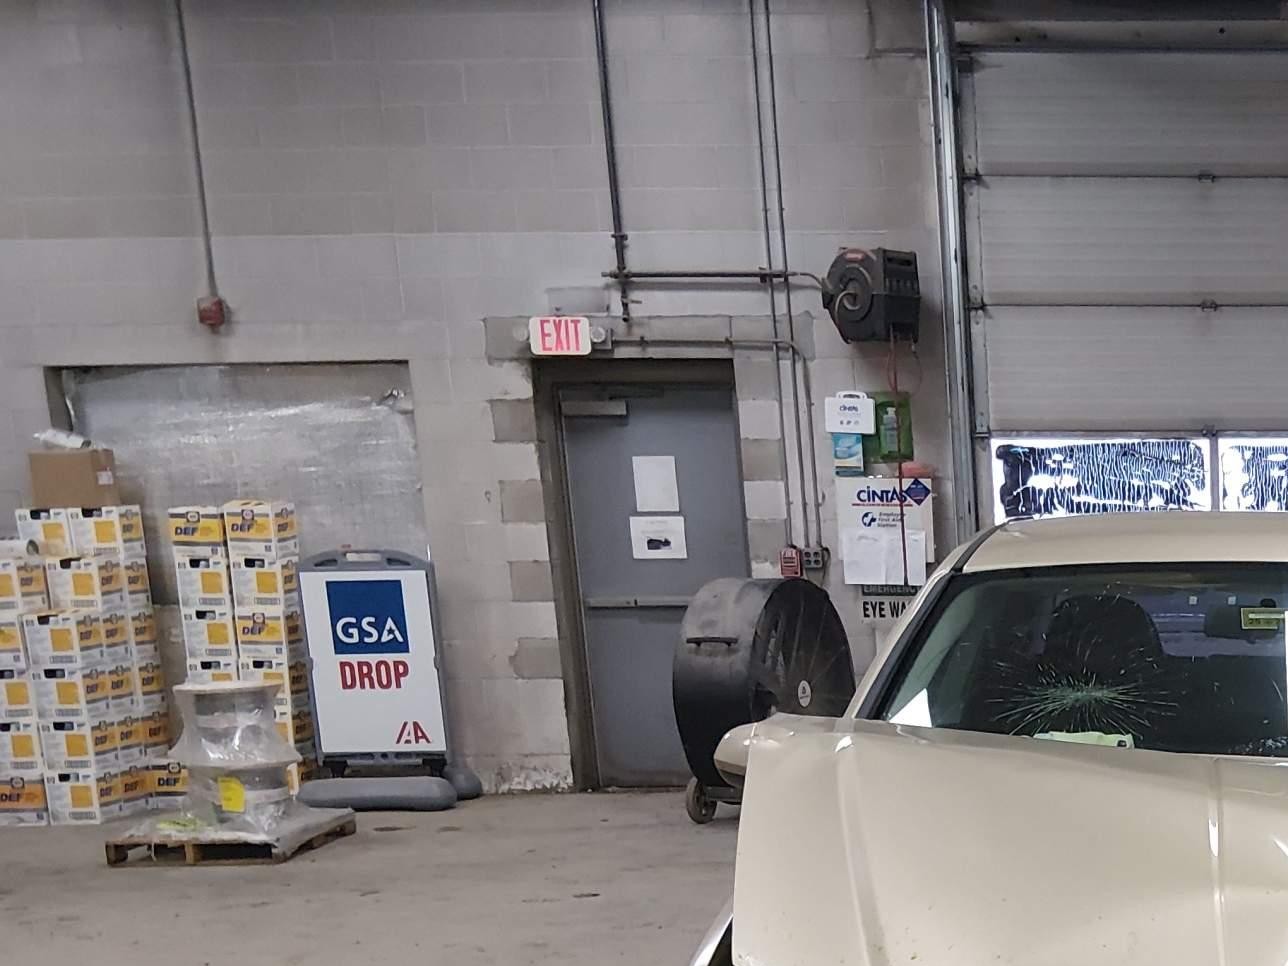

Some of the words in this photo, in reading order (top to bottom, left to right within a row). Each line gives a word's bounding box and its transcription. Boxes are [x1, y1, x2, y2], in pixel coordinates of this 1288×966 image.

[540, 319, 581, 352] EXIT
[174, 526, 198, 536] DEF
[231, 523, 254, 532] DEF
[863, 601, 886, 618] EYE
[889, 601, 907, 618] WA
[336, 616, 404, 644] GSA
[339, 660, 410, 690] DROP
[158, 777, 180, 787] DEF
